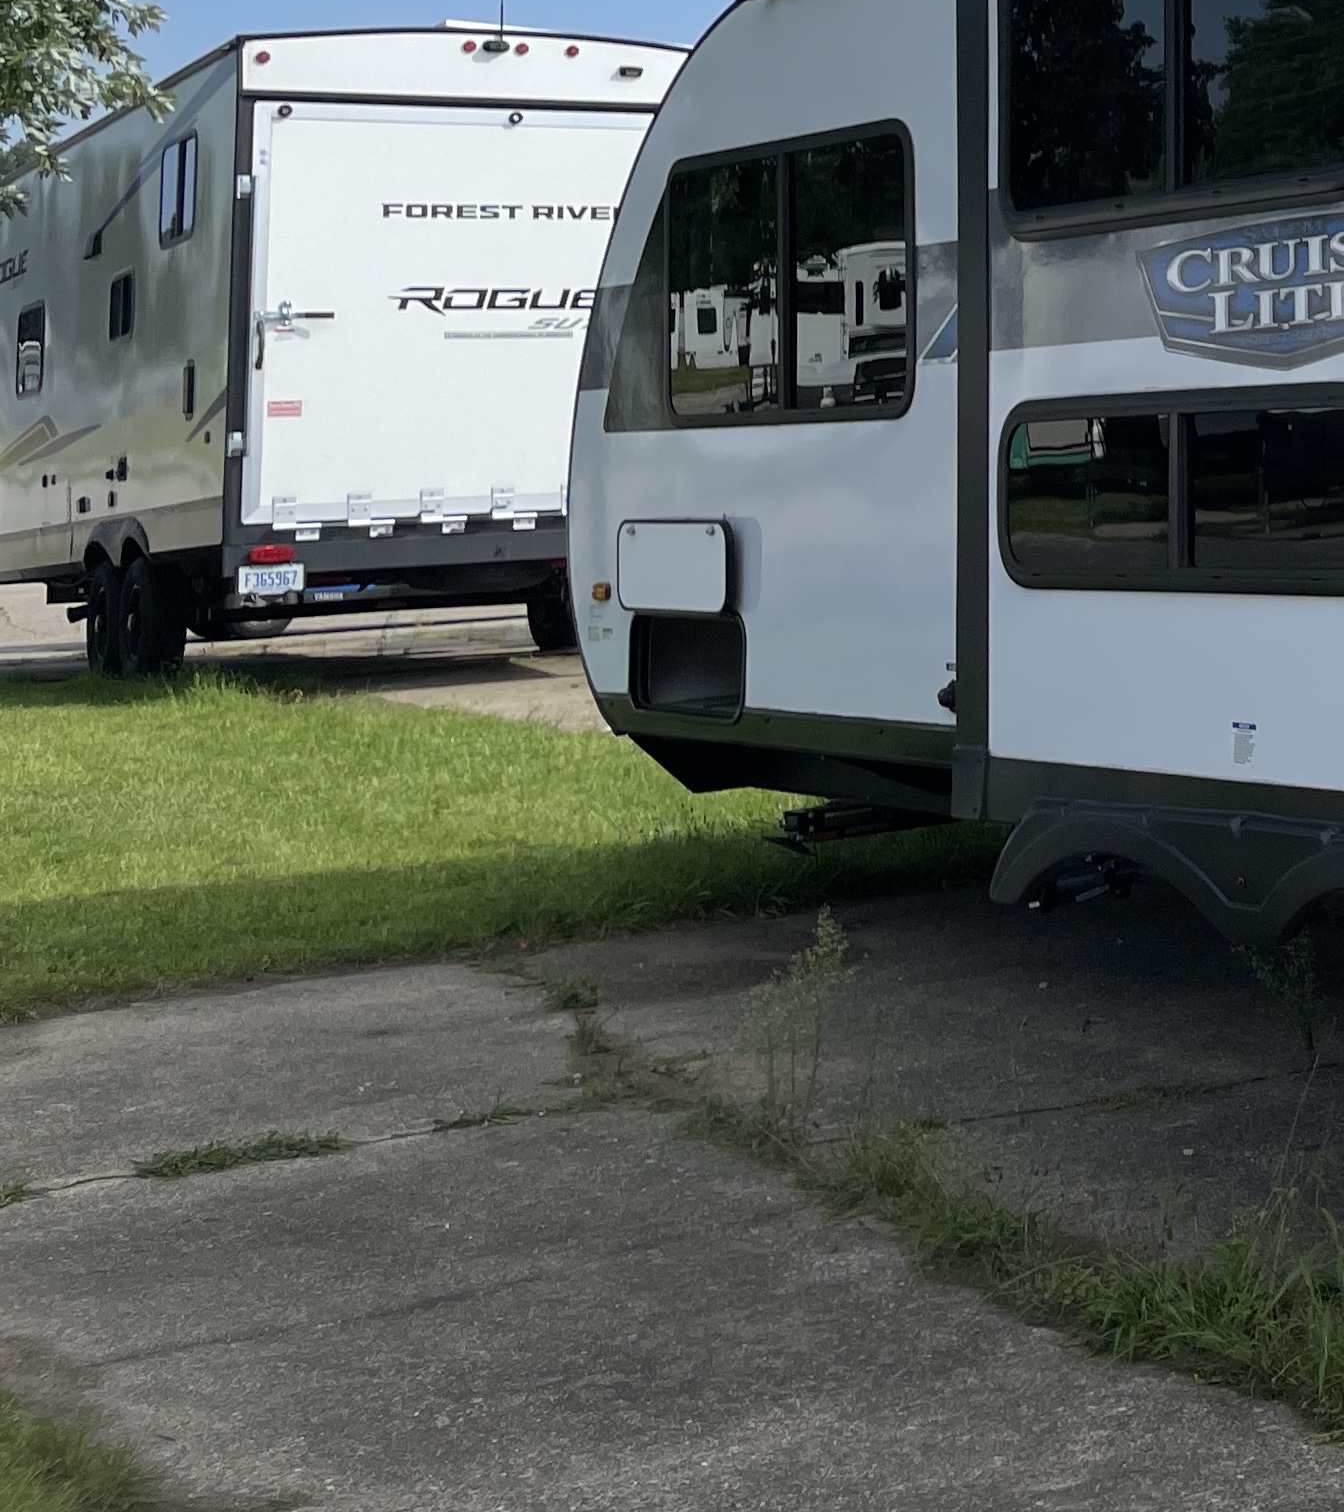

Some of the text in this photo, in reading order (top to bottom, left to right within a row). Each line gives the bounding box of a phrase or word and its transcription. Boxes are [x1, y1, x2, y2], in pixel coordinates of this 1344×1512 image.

[382, 203, 523, 220] FOREST
[388, 285, 596, 317] ROGUE
[528, 317, 589, 330] SU
[244, 569, 298, 589] F365967
